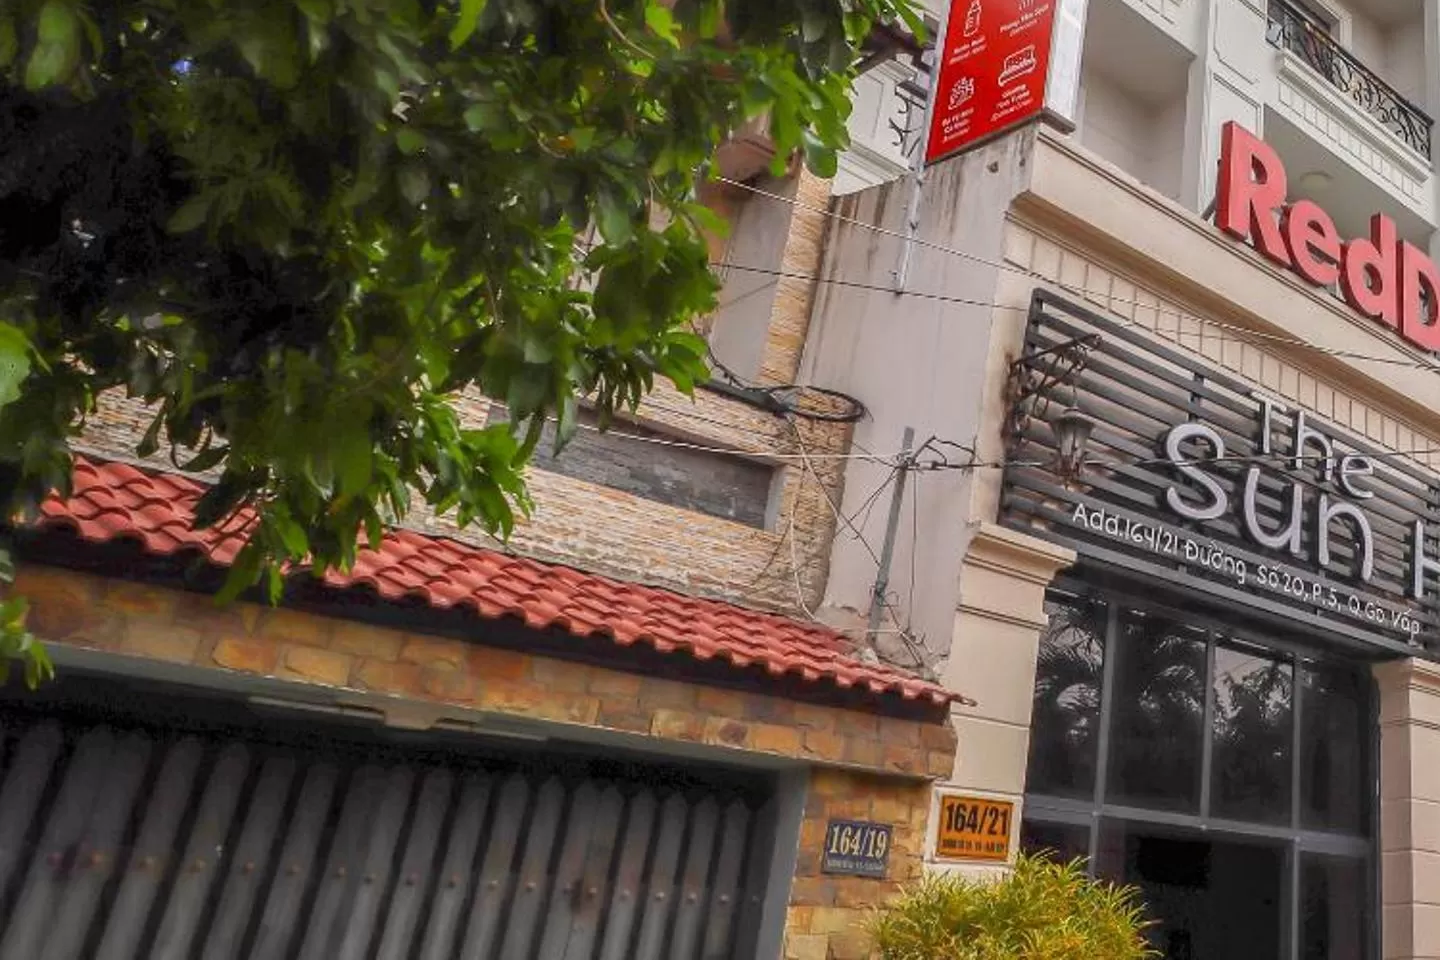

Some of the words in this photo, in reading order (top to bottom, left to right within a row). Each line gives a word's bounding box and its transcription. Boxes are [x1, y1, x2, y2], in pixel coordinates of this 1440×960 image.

[1250, 390, 1375, 499] The
[1072, 502, 1178, 556] Add.164/21
[1185, 540, 1247, 585] Đường
[1165, 422, 1375, 582] Sun
[829, 823, 888, 860] 164/19
[945, 801, 1009, 837] 164/21
